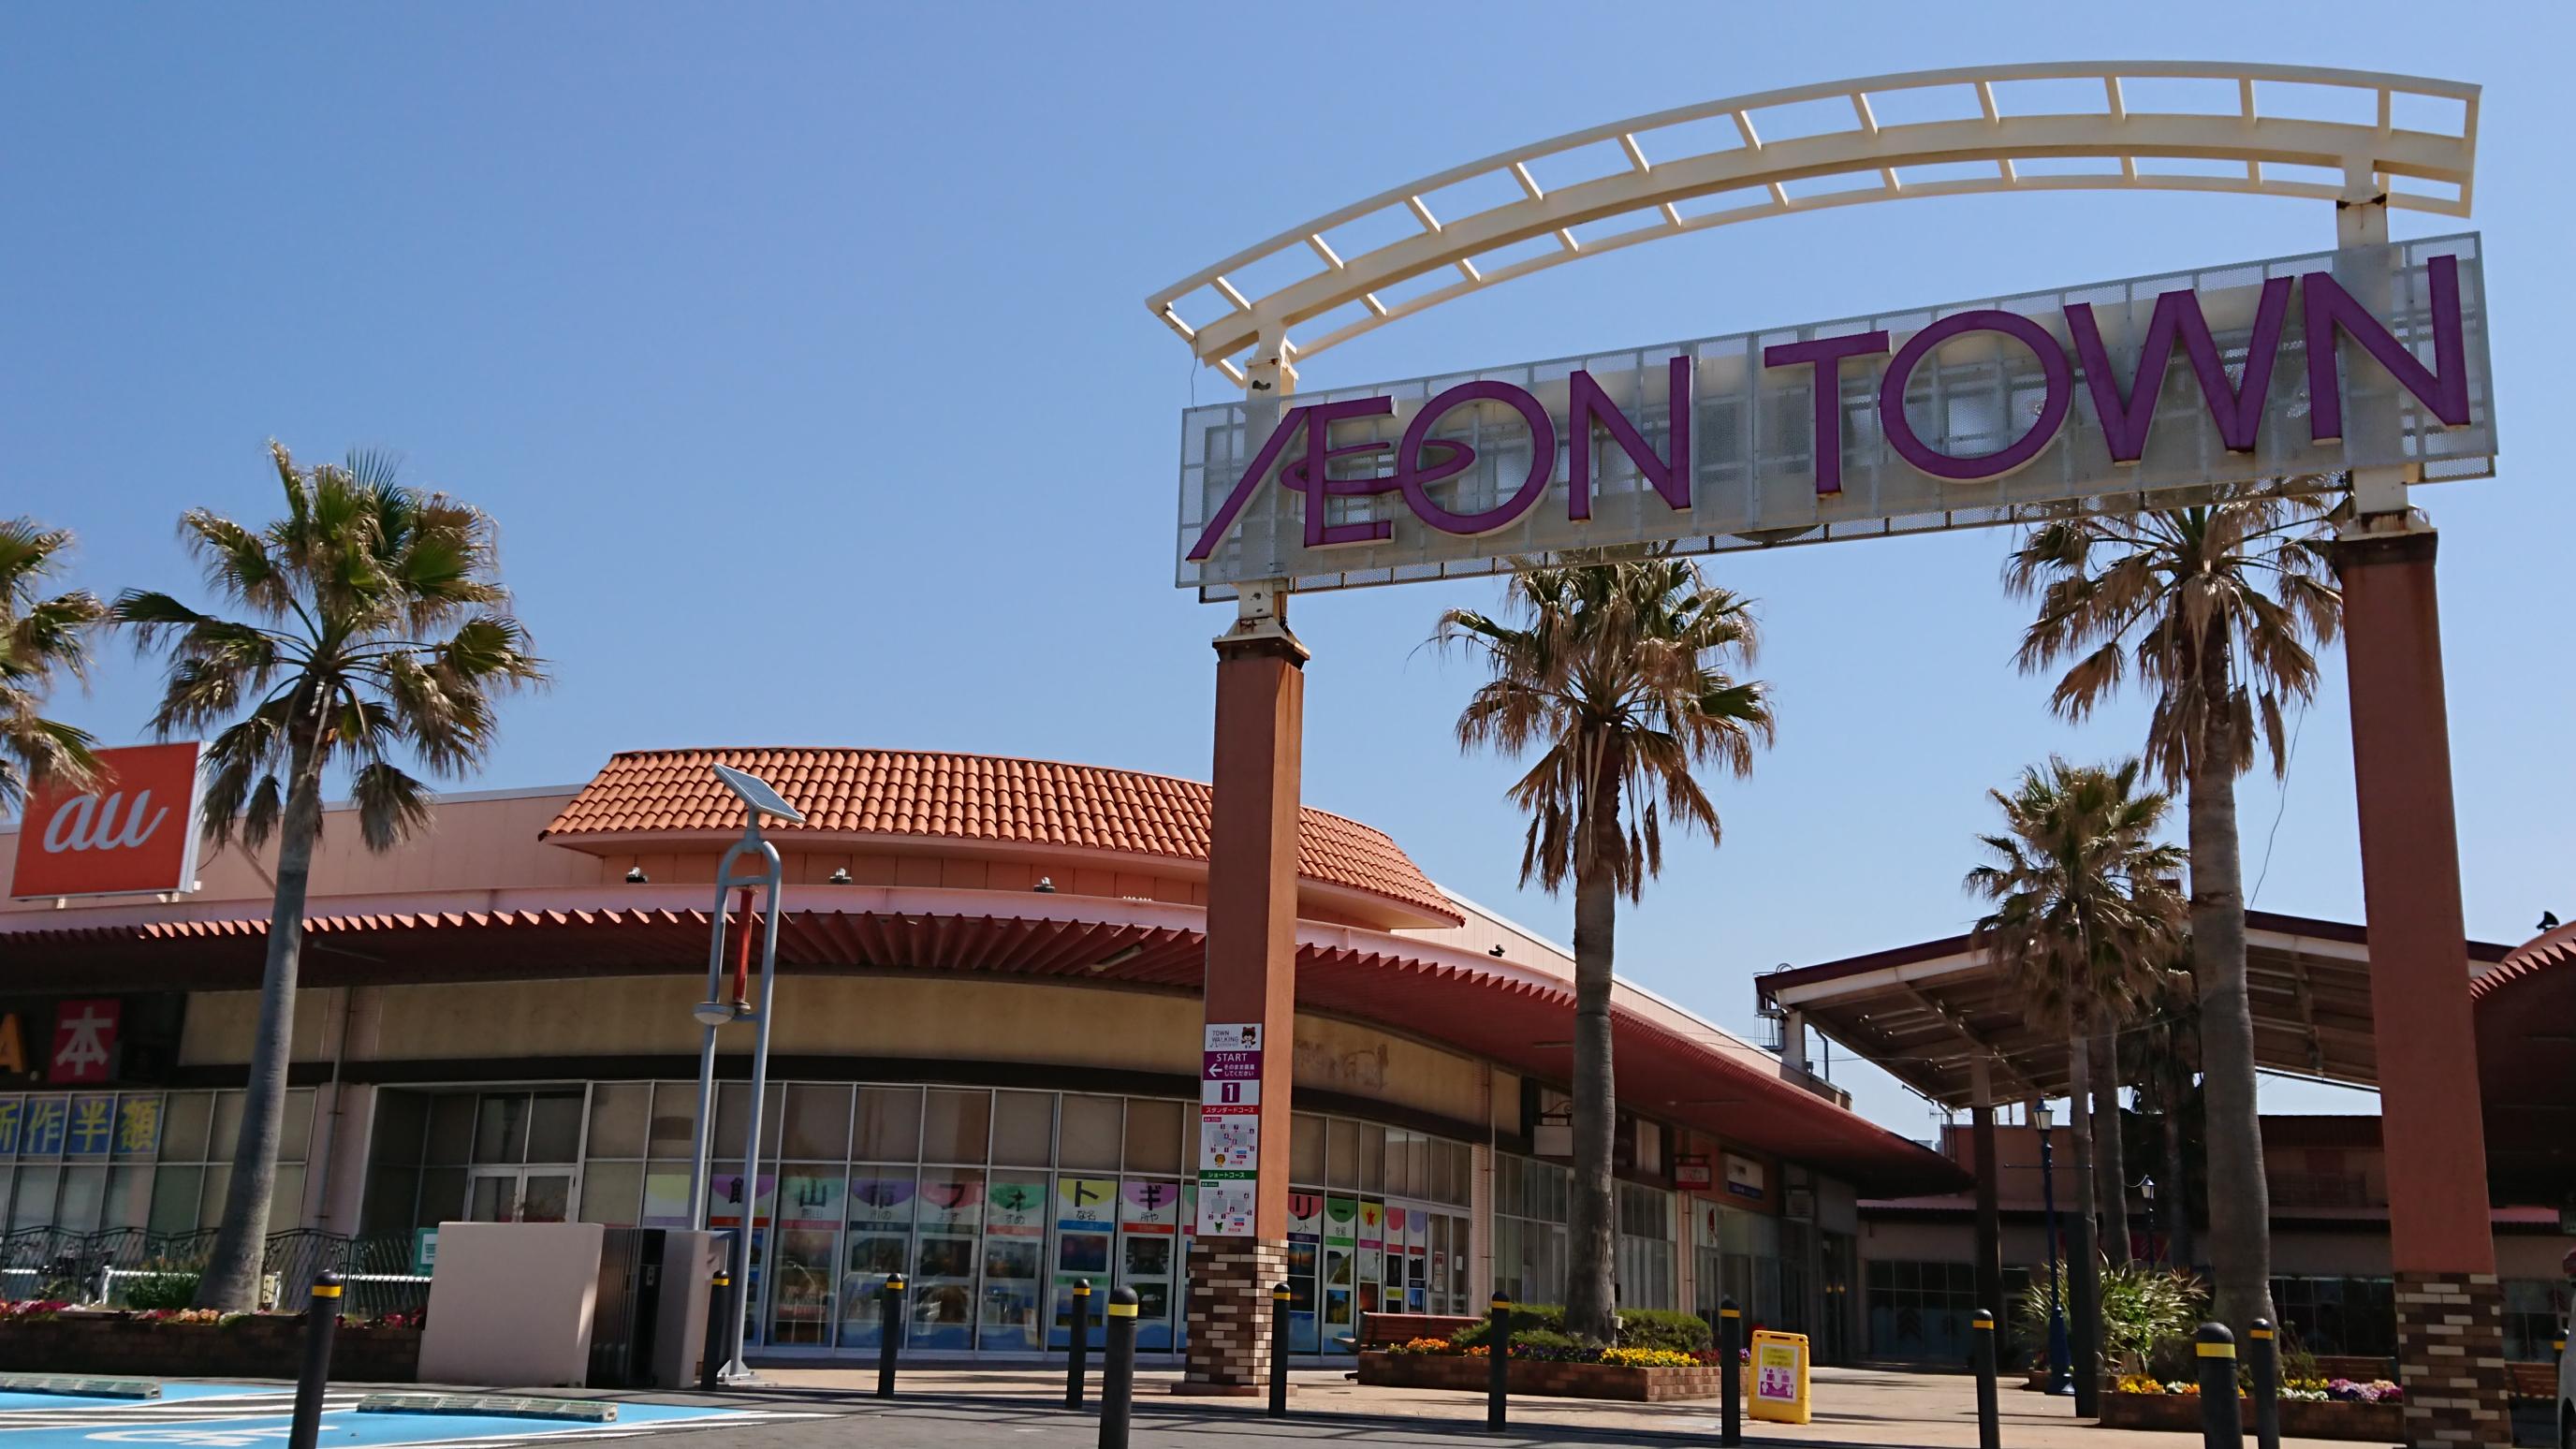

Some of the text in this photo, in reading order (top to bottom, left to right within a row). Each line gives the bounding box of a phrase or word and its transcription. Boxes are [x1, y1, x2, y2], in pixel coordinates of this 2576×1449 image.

[1764, 255, 2471, 498] TOWN
[44, 789, 169, 853] au
[56, 1006, 113, 1076] 本
[1216, 1053, 1248, 1062] START
[1226, 1084, 1235, 1102] 1
